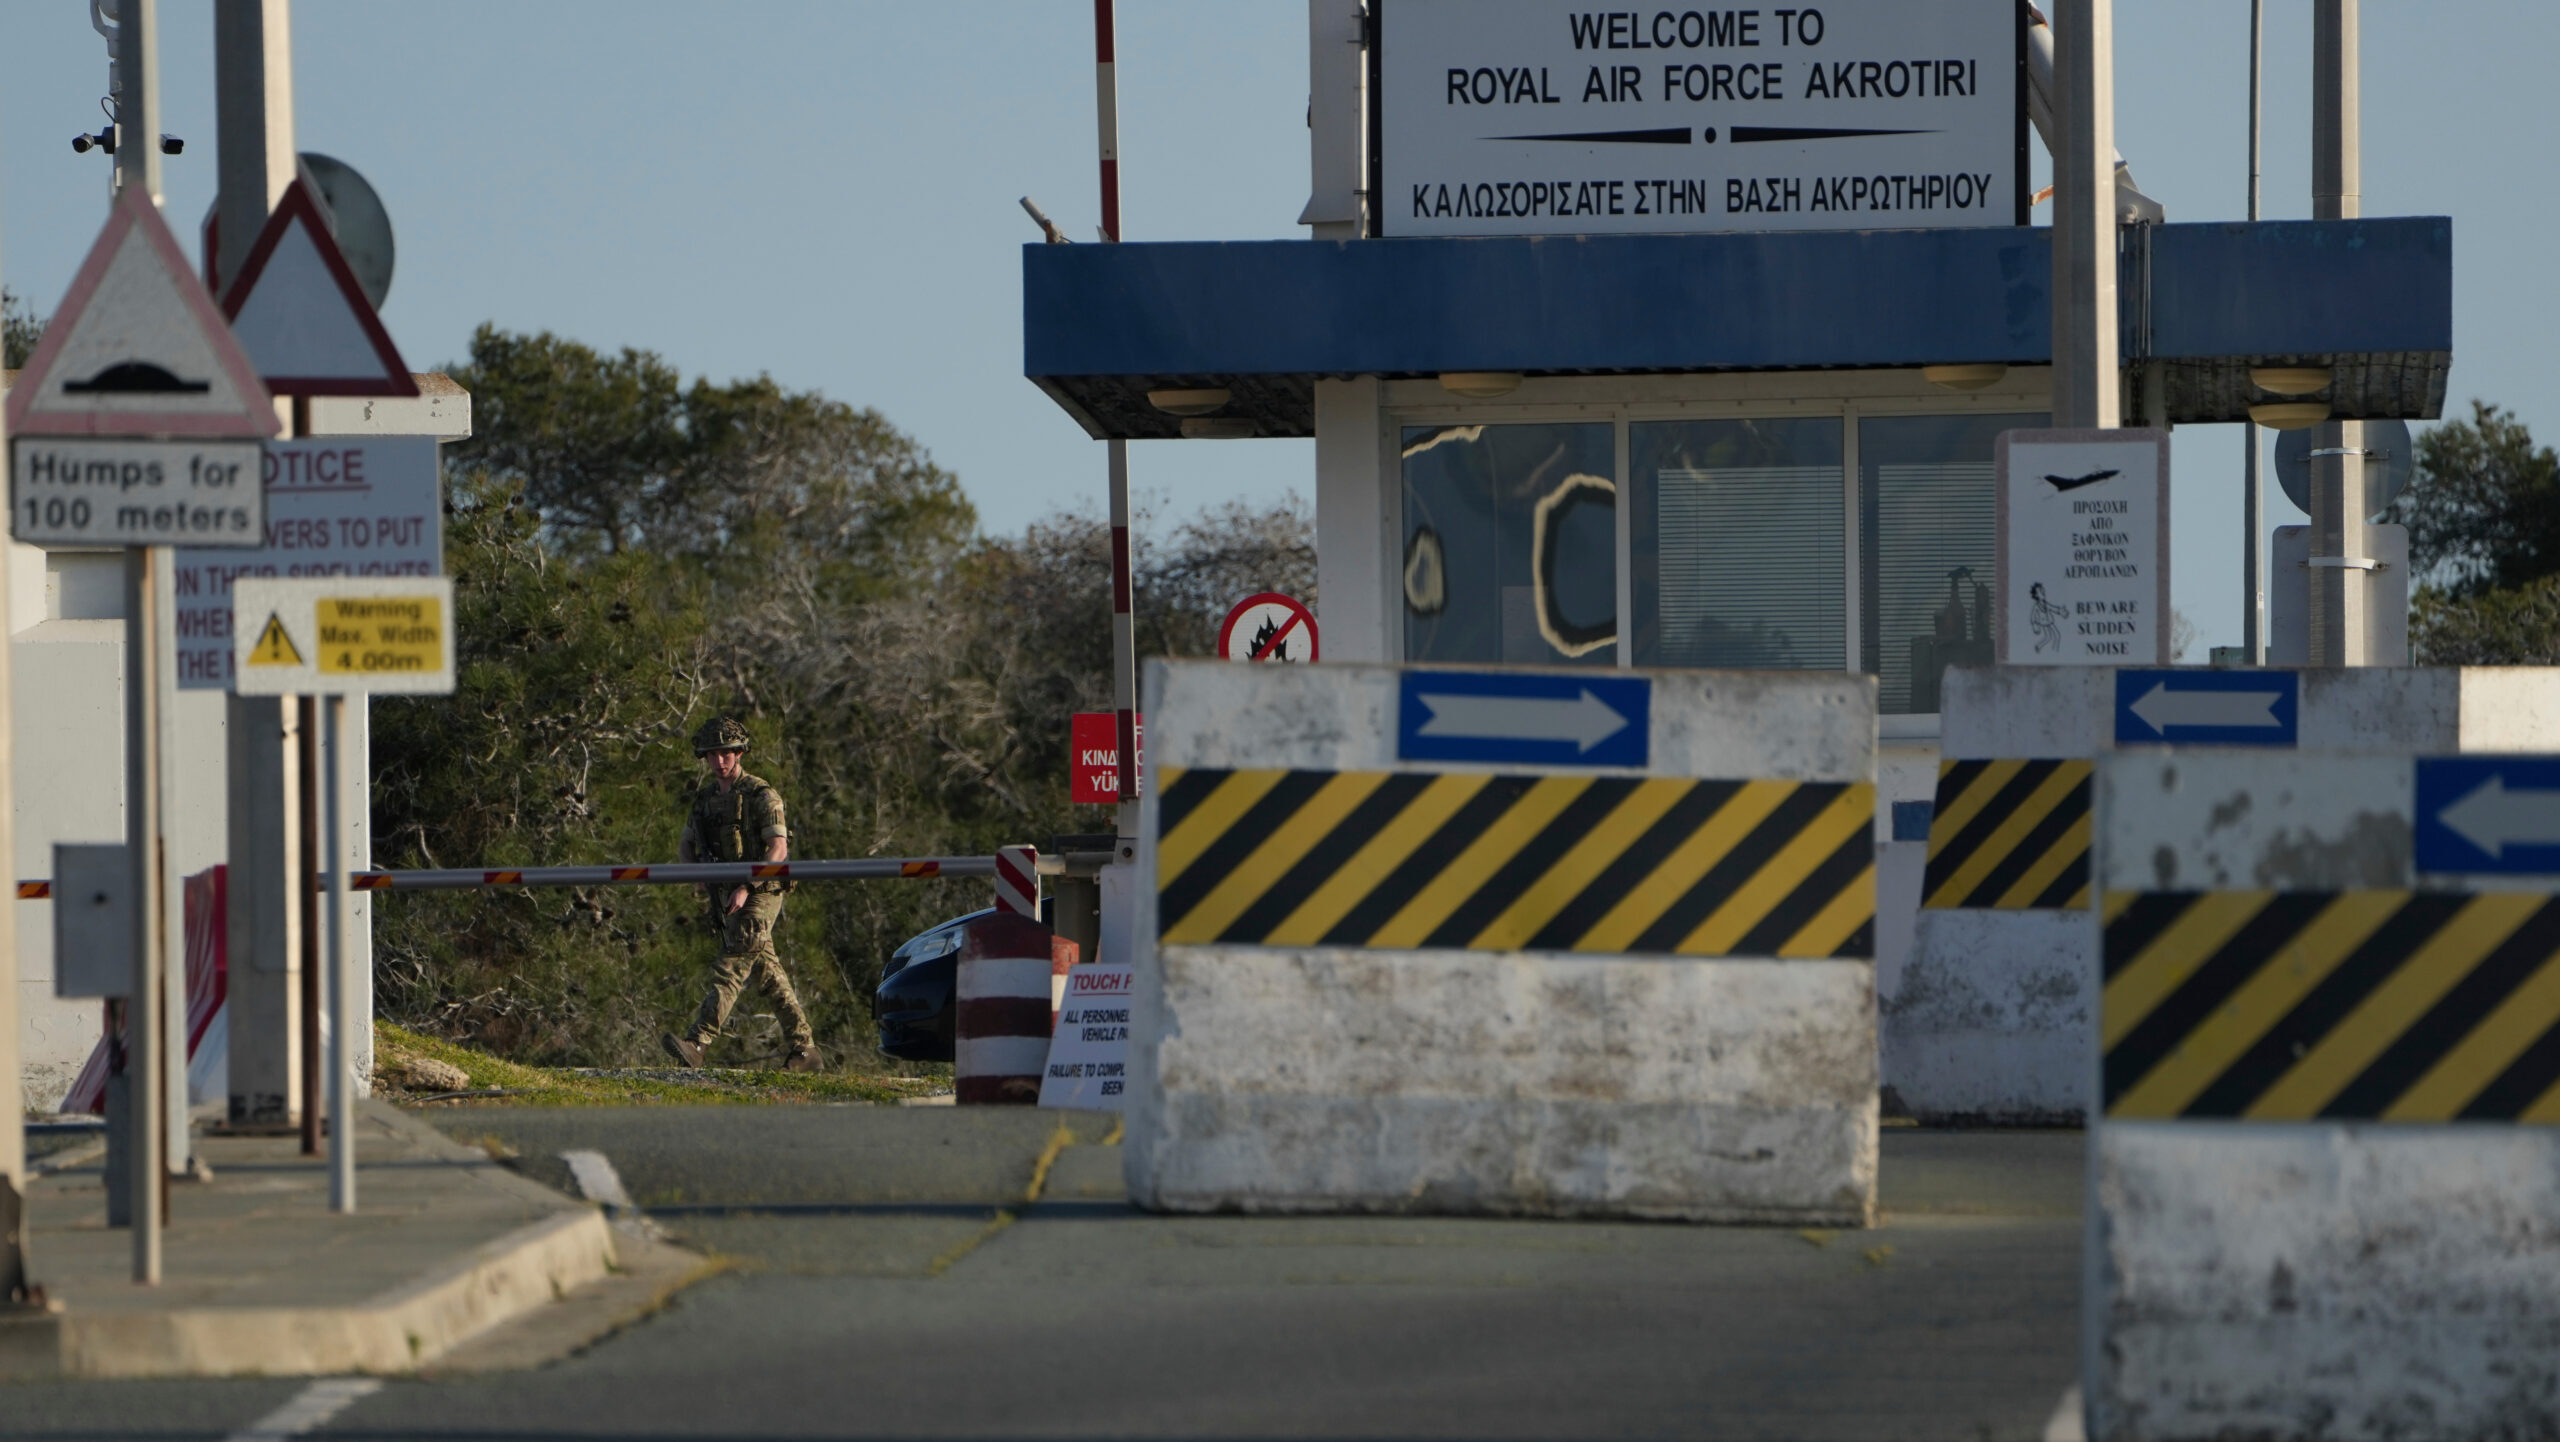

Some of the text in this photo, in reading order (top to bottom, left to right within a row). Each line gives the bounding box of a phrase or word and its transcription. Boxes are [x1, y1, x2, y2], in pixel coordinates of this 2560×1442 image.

[1570, 8, 1825, 50] WELCOME TO
[1447, 59, 1977, 104] ROYAL AIR FORCE AKROTIRI
[1413, 173, 1992, 218] ΚΑΛΩΣΟΡΙΣΑΤΕ ΣΤΗΝ ΒΑΣΗ ΑΚΡΩΤΗΡΙΟΥ
[30, 454, 241, 491] Humps for
[264, 449, 364, 484] OTICE
[23, 498, 250, 533] 100 meters
[2073, 500, 2128, 514] ΠΡΟΣΟΧΗ
[337, 517, 371, 548] TO
[377, 516, 424, 547] PUT
[2089, 517, 2113, 530] ΑΠΟ
[336, 600, 422, 621] Warning
[2076, 600, 2138, 615] BEWARE
[320, 625, 437, 645] Max. Width
[2078, 621, 2136, 635] SUDDEN
[2085, 642, 2129, 656] NOISE
[337, 652, 422, 671] 4.00m
[1073, 973, 1121, 990] TOUCH
[1064, 1010, 1079, 1024] ALL
[1081, 1028, 1116, 1042] VEHICLE
[1048, 1063, 1126, 1078] FAILURE TO COMPL
[1101, 1081, 1125, 1095] BEEN
